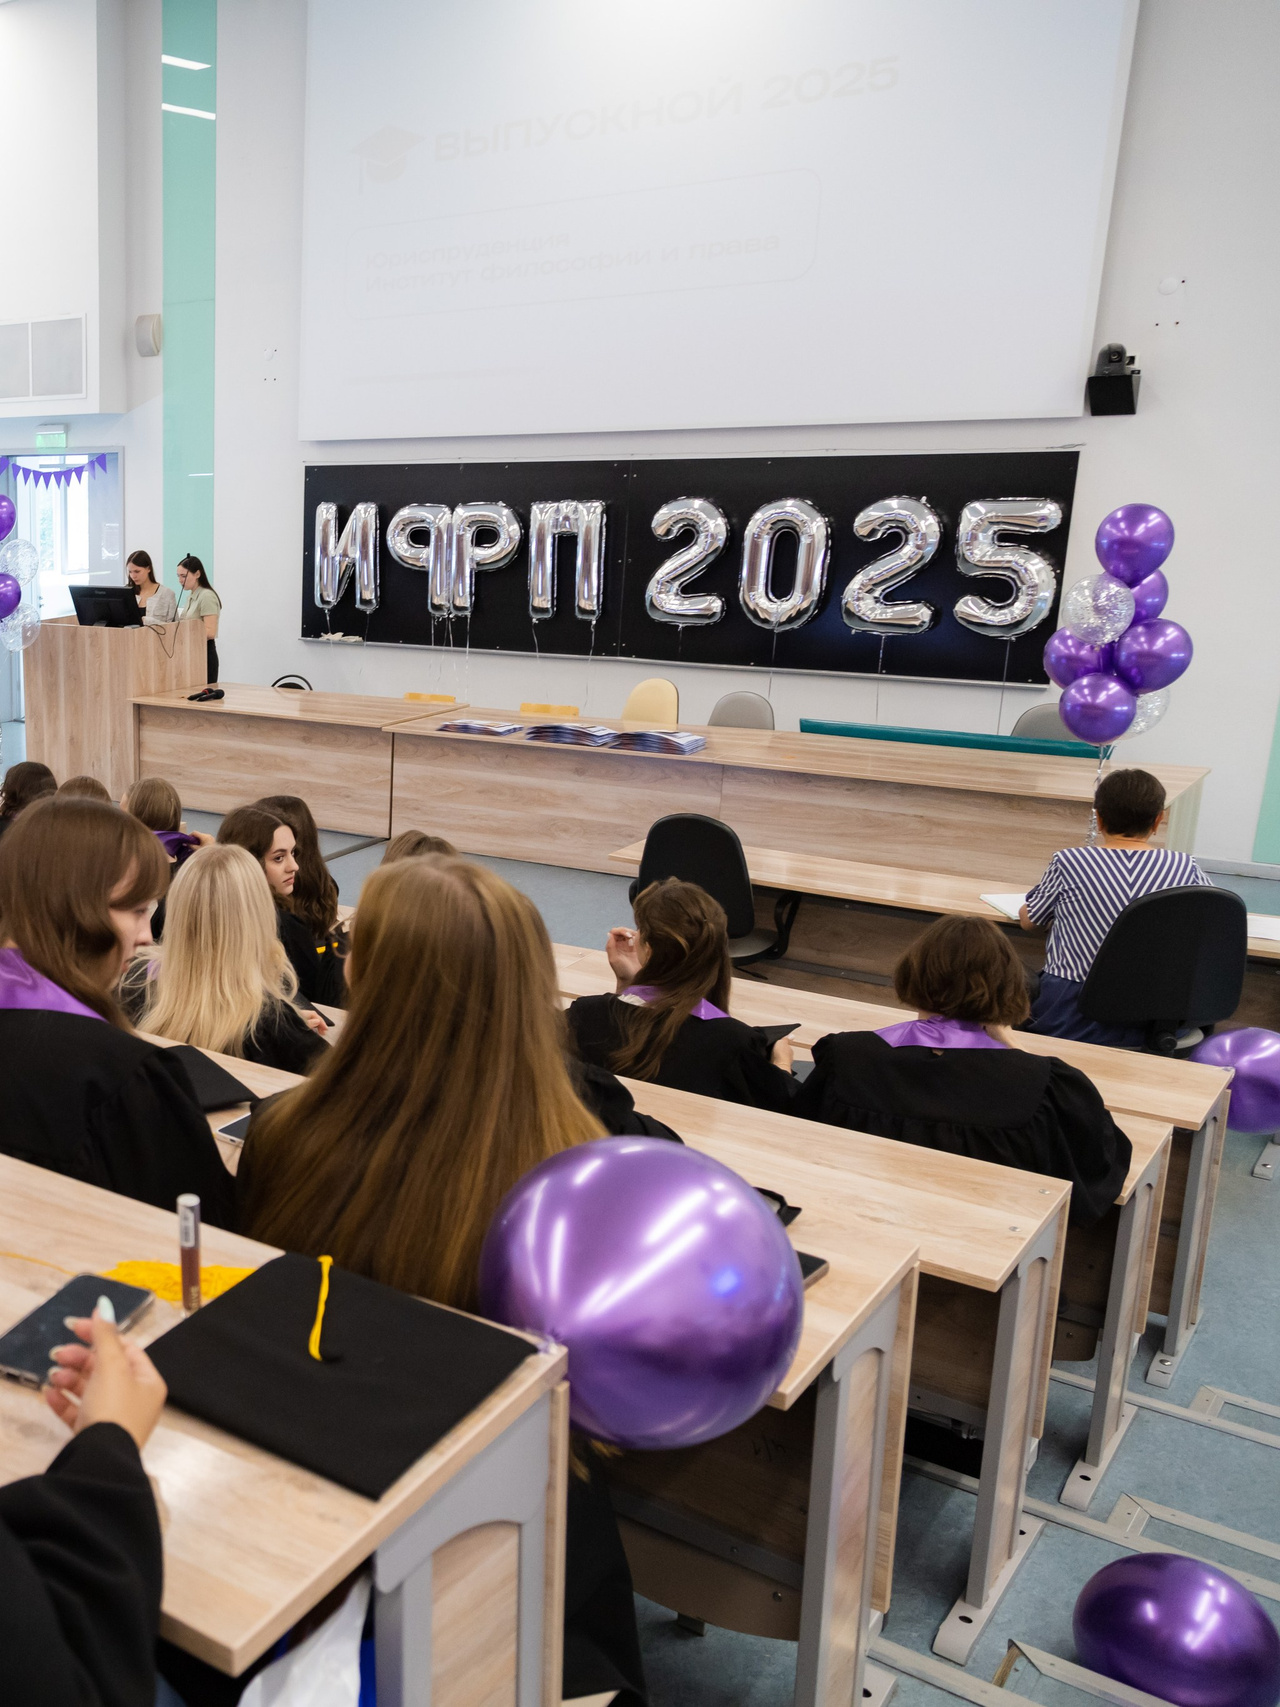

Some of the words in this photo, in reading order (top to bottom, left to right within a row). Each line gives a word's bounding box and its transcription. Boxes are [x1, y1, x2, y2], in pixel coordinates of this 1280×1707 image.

[433, 76, 743, 162] ВЫПУСКНОЙ
[760, 55, 901, 111] 2025
[480, 249, 652, 284] философии
[661, 246, 679, 264] и
[689, 231, 781, 264] права
[315, 499, 607, 621] ИФП
[643, 494, 1066, 640] 2025
